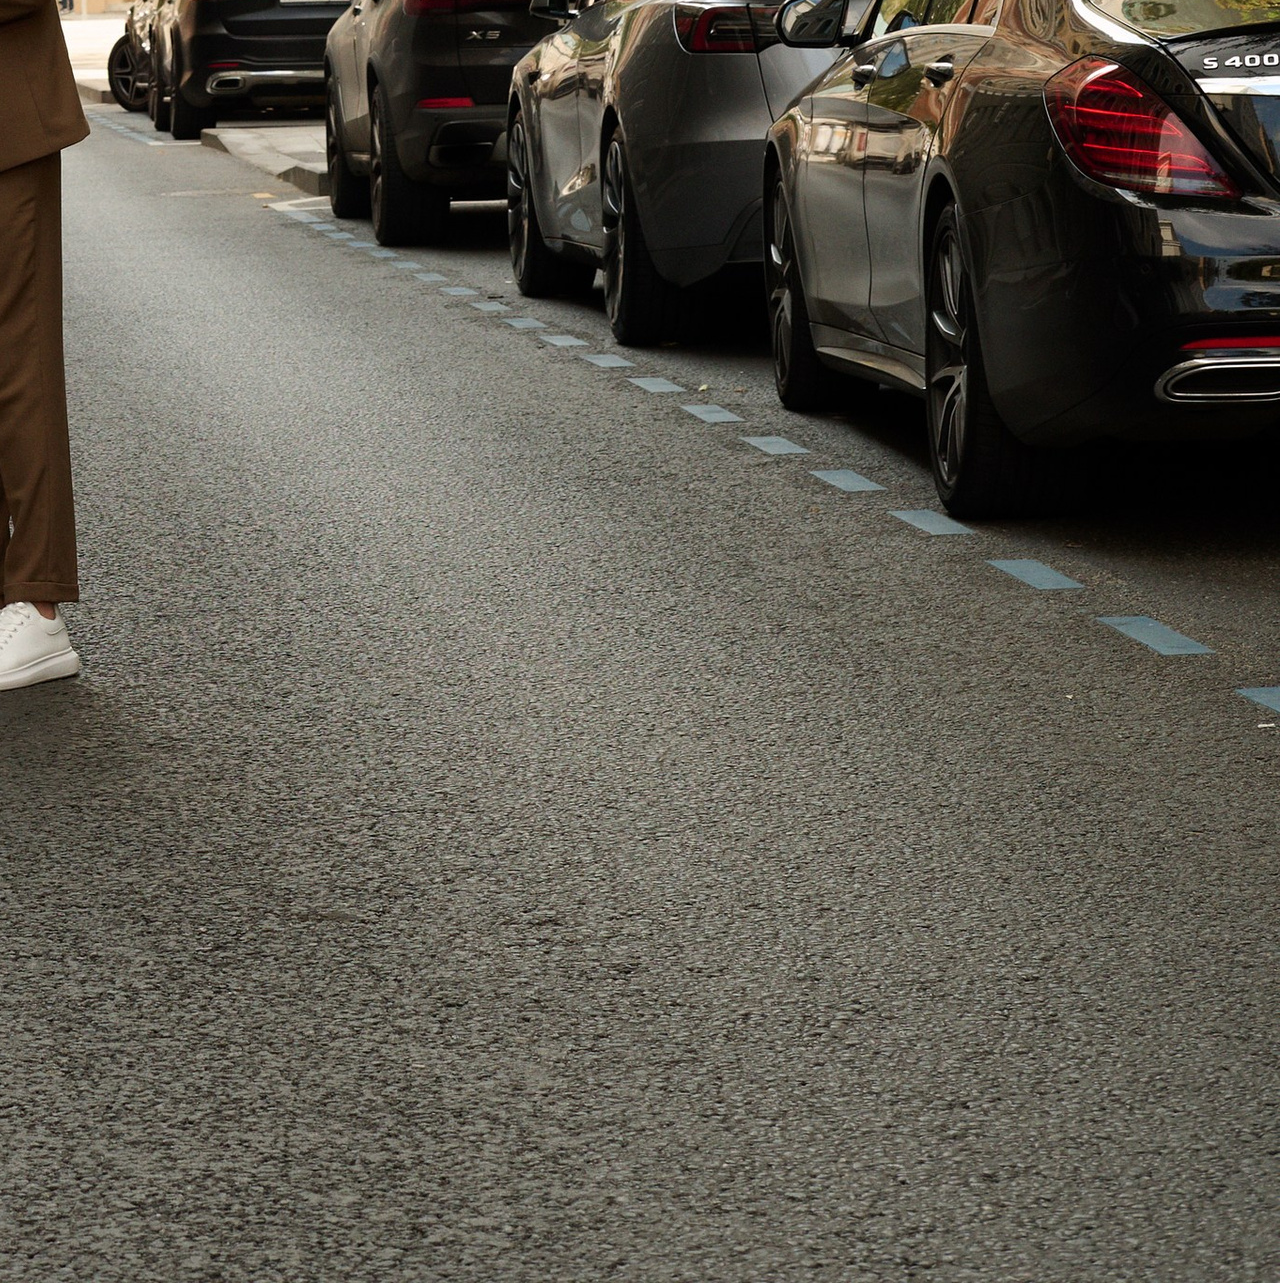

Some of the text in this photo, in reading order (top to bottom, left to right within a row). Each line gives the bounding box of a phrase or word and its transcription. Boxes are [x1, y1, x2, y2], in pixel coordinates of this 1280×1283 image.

[465, 30, 501, 40] X5
[1203, 54, 1279, 70] S 400
